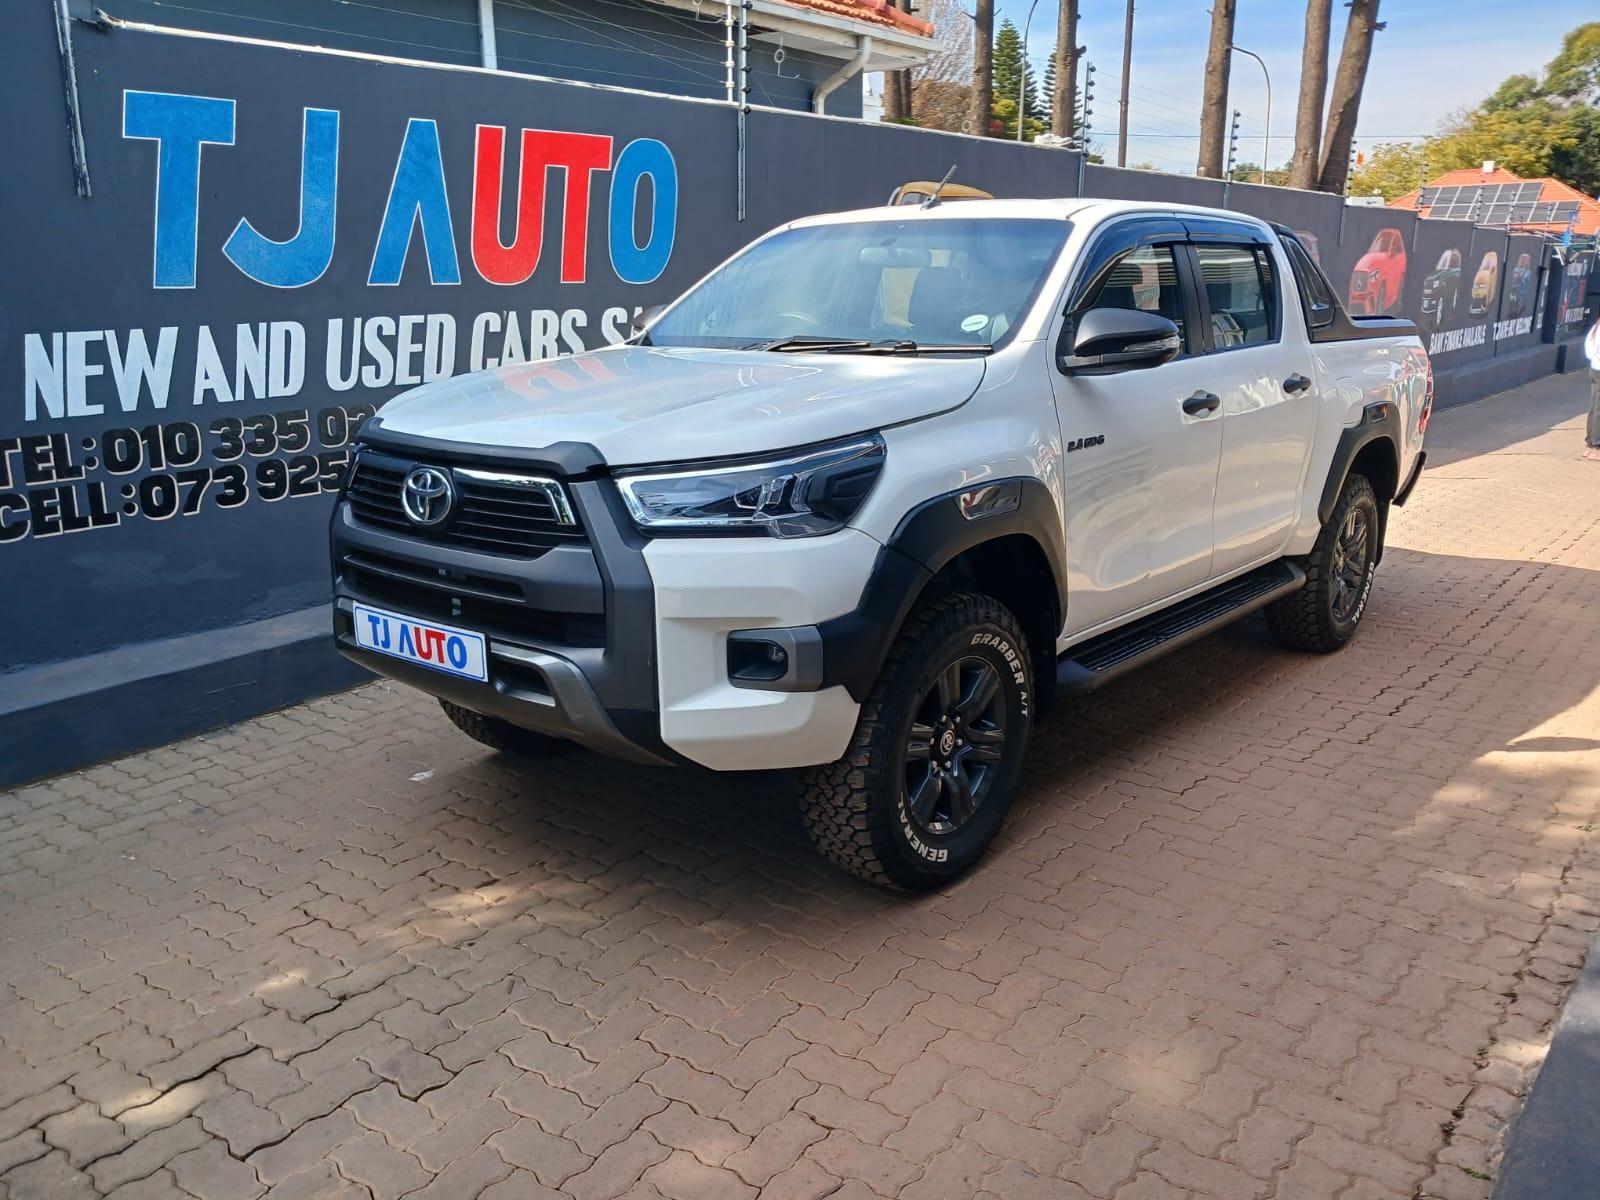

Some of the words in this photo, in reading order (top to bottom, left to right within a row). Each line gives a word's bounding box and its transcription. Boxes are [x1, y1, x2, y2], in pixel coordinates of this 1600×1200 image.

[122, 89, 340, 289] TJ
[367, 117, 679, 286] AUTO
[24, 326, 179, 421] NEW
[193, 320, 305, 405] AND
[325, 312, 456, 391] USED
[470, 308, 588, 373] CARS
[601, 306, 643, 346] S
[209, 409, 311, 462] 335
[255, 449, 350, 503] 925
[367, 614, 391, 650] TJ
[399, 622, 468, 670] AUTO
[970, 632, 1025, 685] GRABBER
[897, 791, 949, 863] GENERAL
